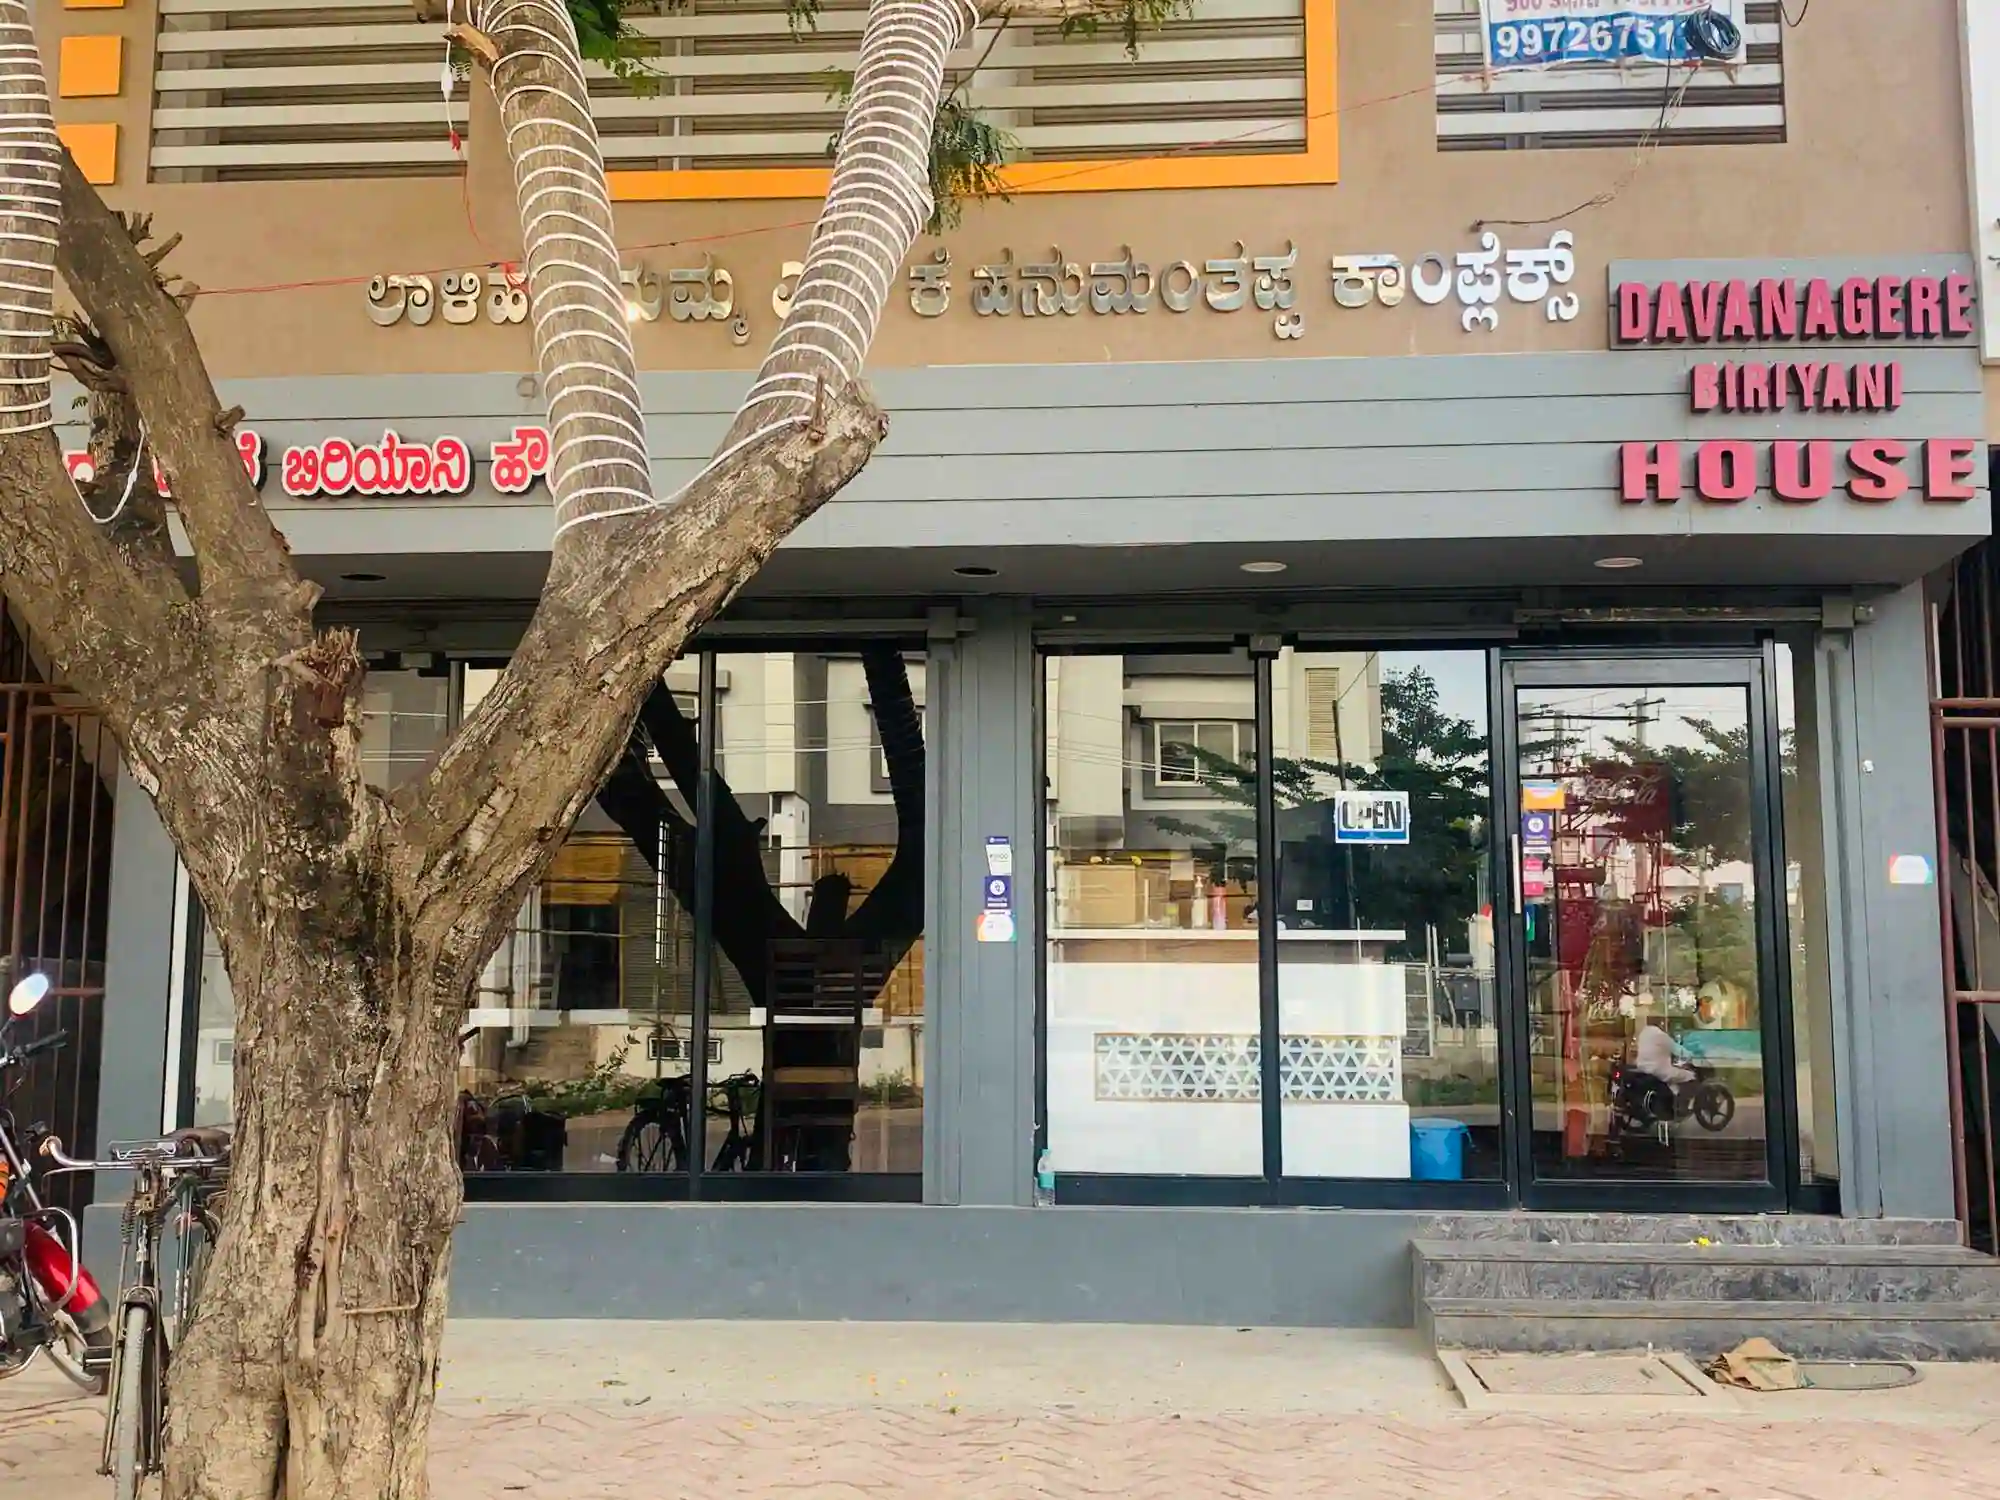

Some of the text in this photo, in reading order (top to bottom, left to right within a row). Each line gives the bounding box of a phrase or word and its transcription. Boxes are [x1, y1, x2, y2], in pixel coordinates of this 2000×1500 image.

[972, 239, 1304, 340] ಹನುಮಂತಪ್ಪ
[1331, 229, 1579, 332] ಕಾಂಪ್ಲೆಕ್ಸ್
[1618, 273, 1976, 343] DAVANAGERE
[1690, 361, 1904, 414] BIRIYANI
[282, 428, 470, 495] ಬಿರಿಯಾನಿ
[1620, 439, 1976, 503] HOUSE
